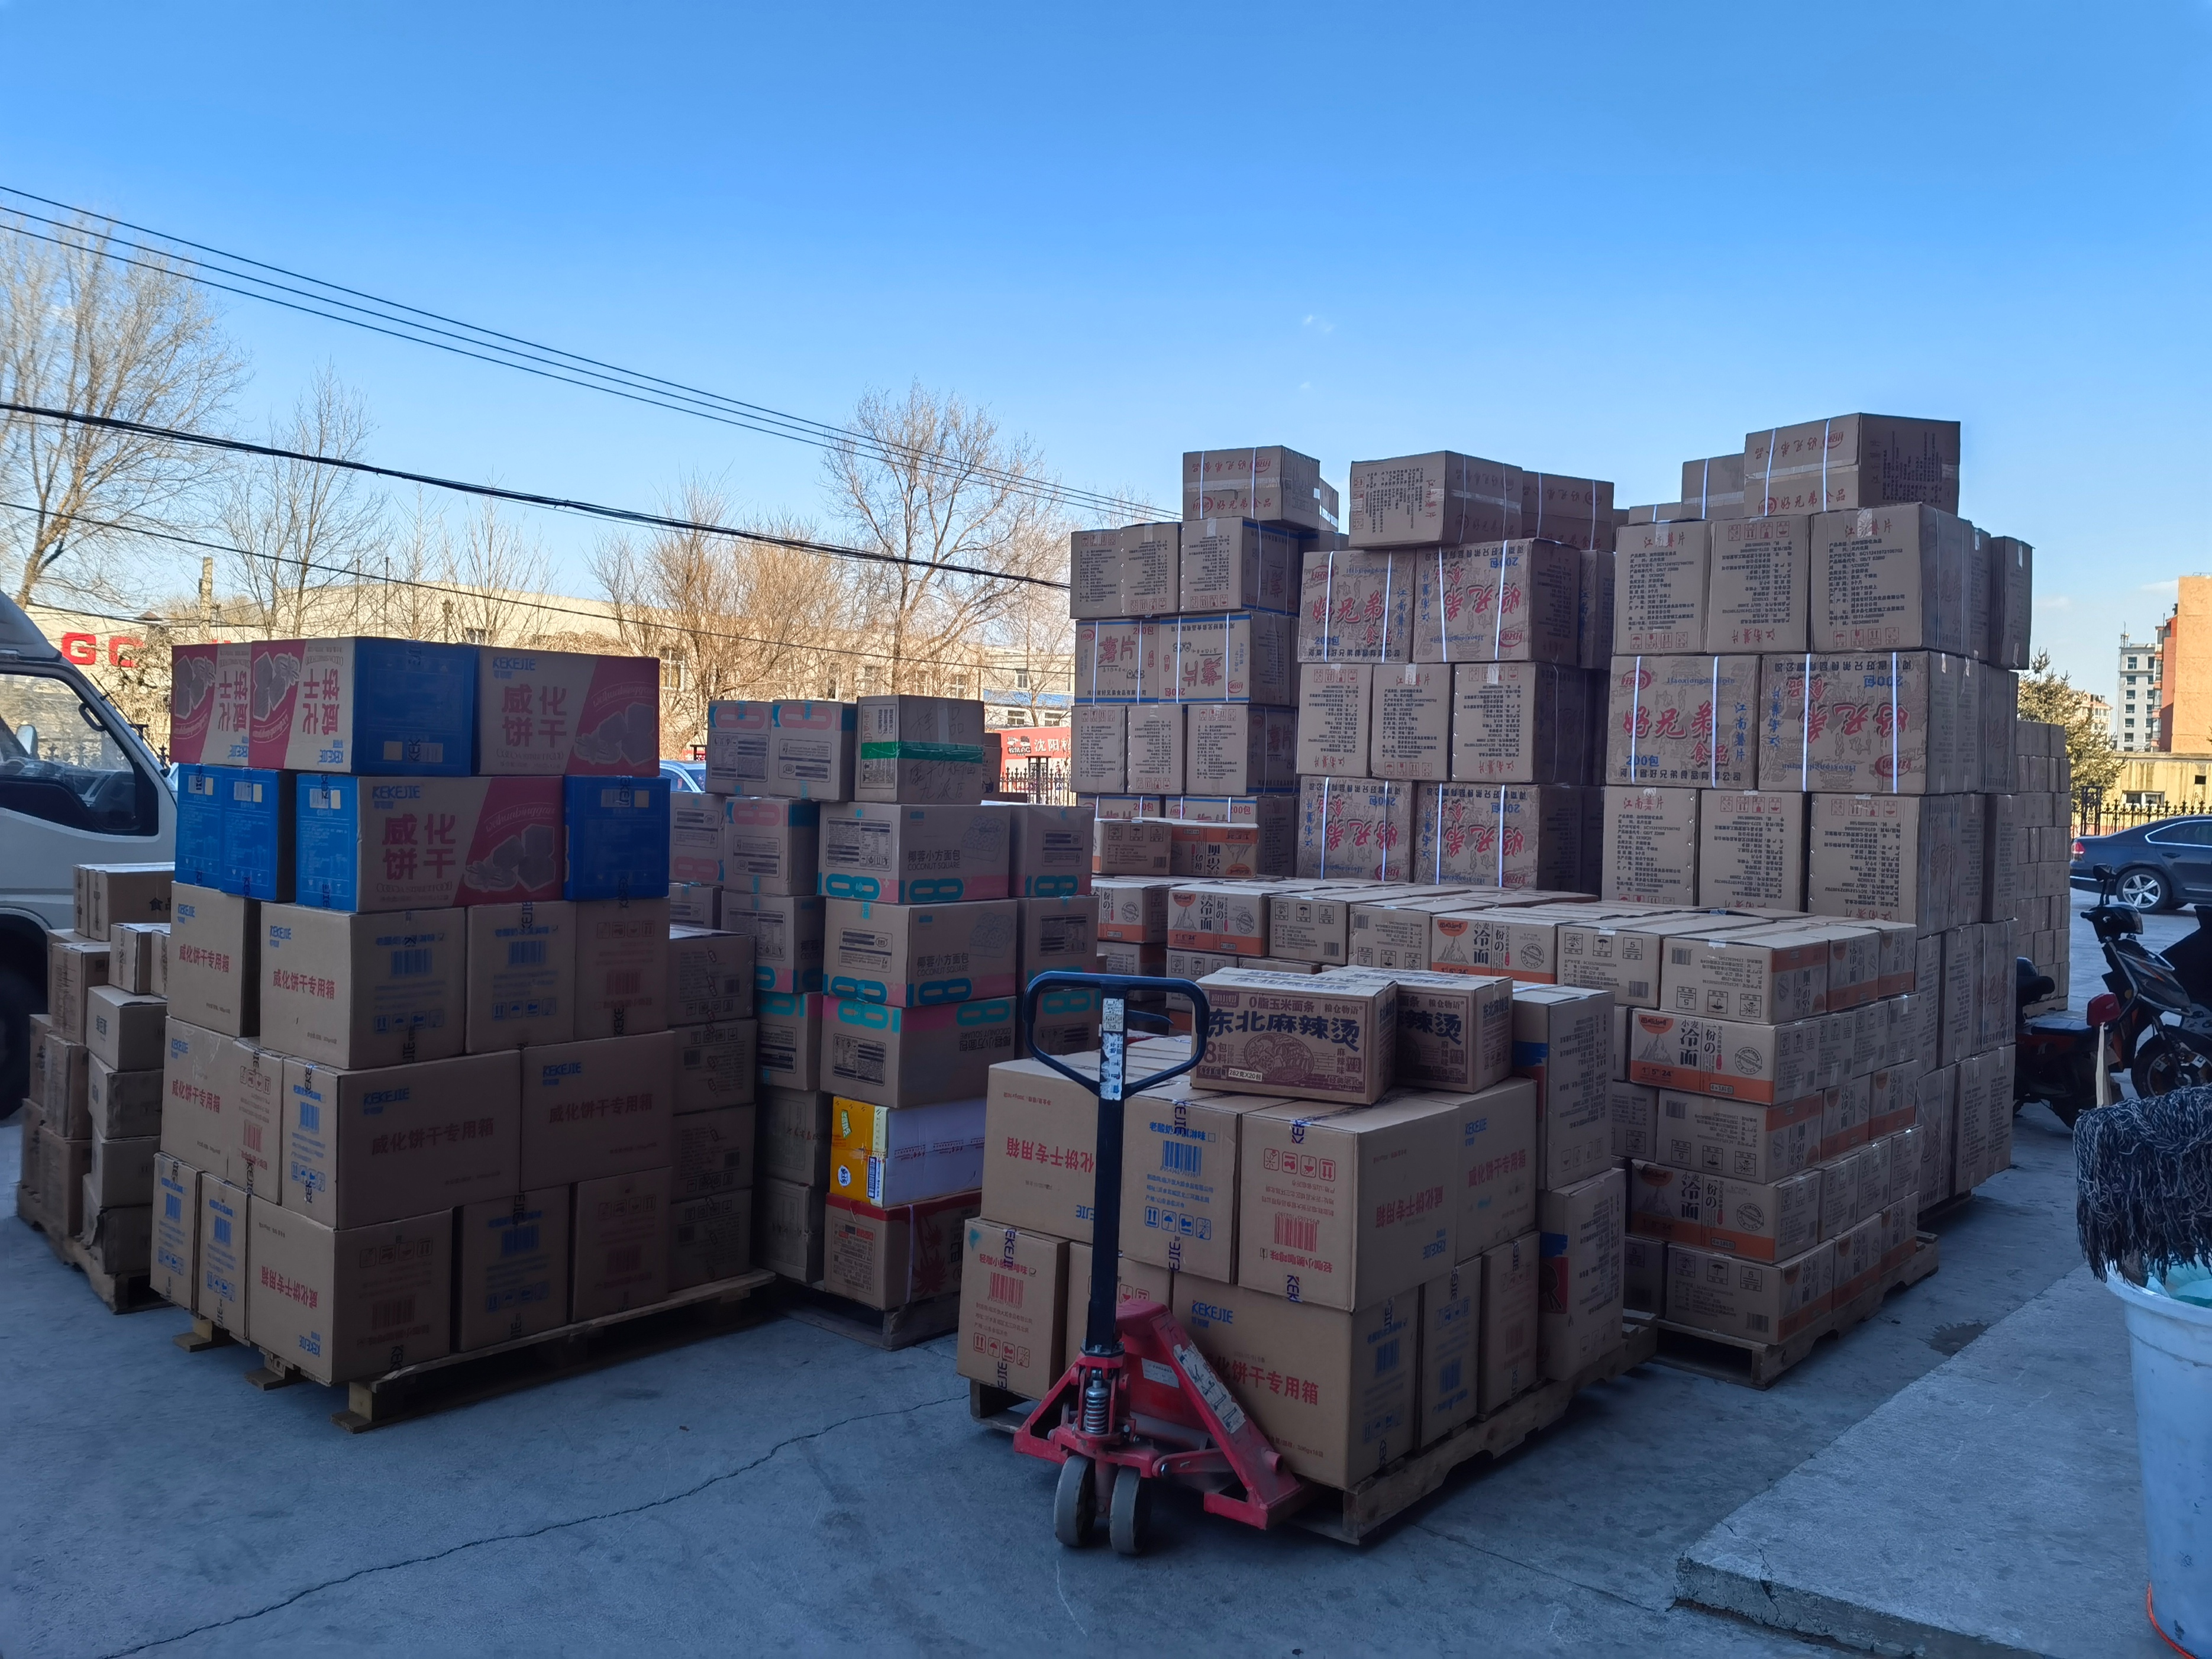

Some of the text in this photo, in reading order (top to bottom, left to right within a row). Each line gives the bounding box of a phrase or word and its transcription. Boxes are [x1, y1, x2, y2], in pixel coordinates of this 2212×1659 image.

[493, 658, 536, 672] KEKEJIE
[501, 684, 567, 715] 威化
[501, 719, 567, 748] 饼干
[372, 786, 421, 799] KEKEJIE
[382, 814, 456, 845] 威化
[383, 848, 456, 880] 饼干
[908, 849, 961, 864] 椰蓉小方面包
[1200, 900, 1213, 931] 冷面
[179, 944, 230, 973] 威化饼干专用箱
[1473, 929, 1491, 964] 冷面
[272, 969, 335, 1000] 威化饼干专用箱
[1249, 996, 1315, 1013] 0脂玉米面条
[1325, 1003, 1359, 1014] 粮仓物语
[1207, 1008, 1360, 1052] 东北麻辣烫
[1679, 1028, 1699, 1067] 冷面
[171, 1079, 221, 1113] 威化饼干专用箱
[549, 1093, 654, 1124] 威化饼干专用箱
[372, 1117, 495, 1156] 威化饼干专用箱
[1681, 1180, 1701, 1221] 冷面
[1191, 1300, 1234, 1323] KEKEJIE
